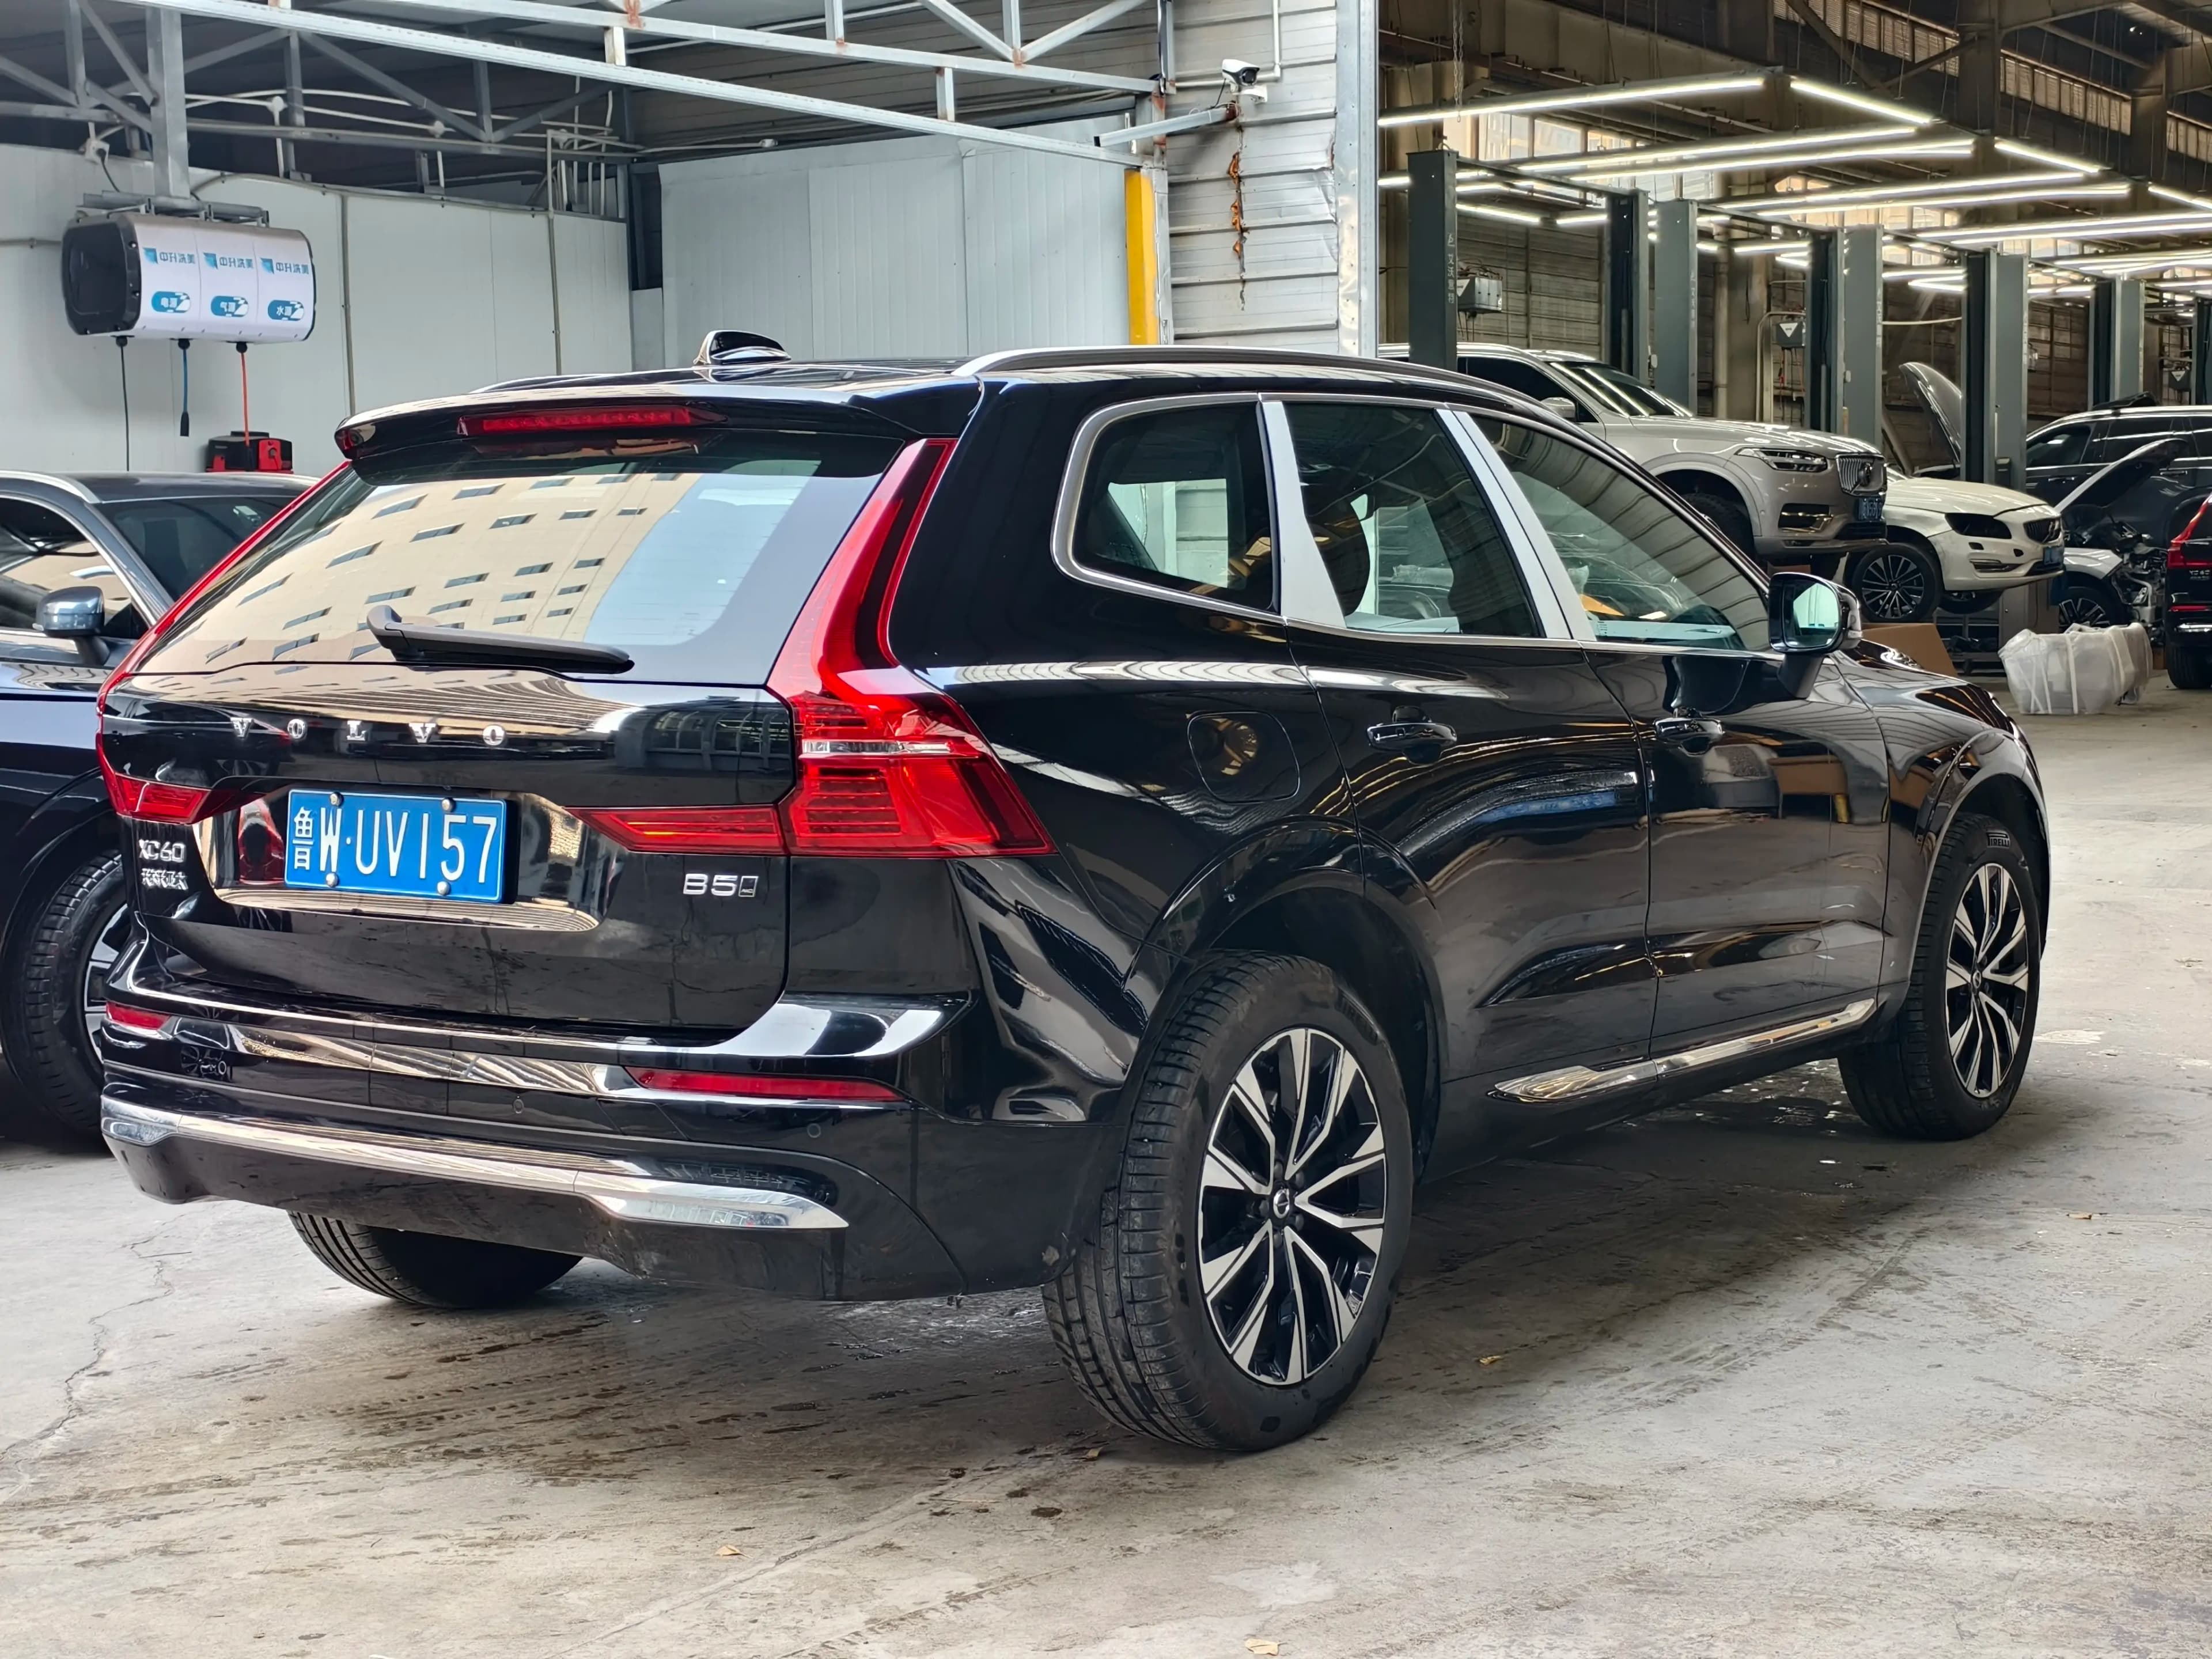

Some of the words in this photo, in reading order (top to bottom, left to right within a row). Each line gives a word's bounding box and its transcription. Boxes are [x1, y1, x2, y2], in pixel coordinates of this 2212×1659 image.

[231, 717, 507, 747] VOLVO
[139, 839, 186, 863] XC60
[293, 806, 498, 883] 鲁W·UV157
[1987, 832, 2010, 847] PIRELLI
[683, 873, 738, 896] B5
